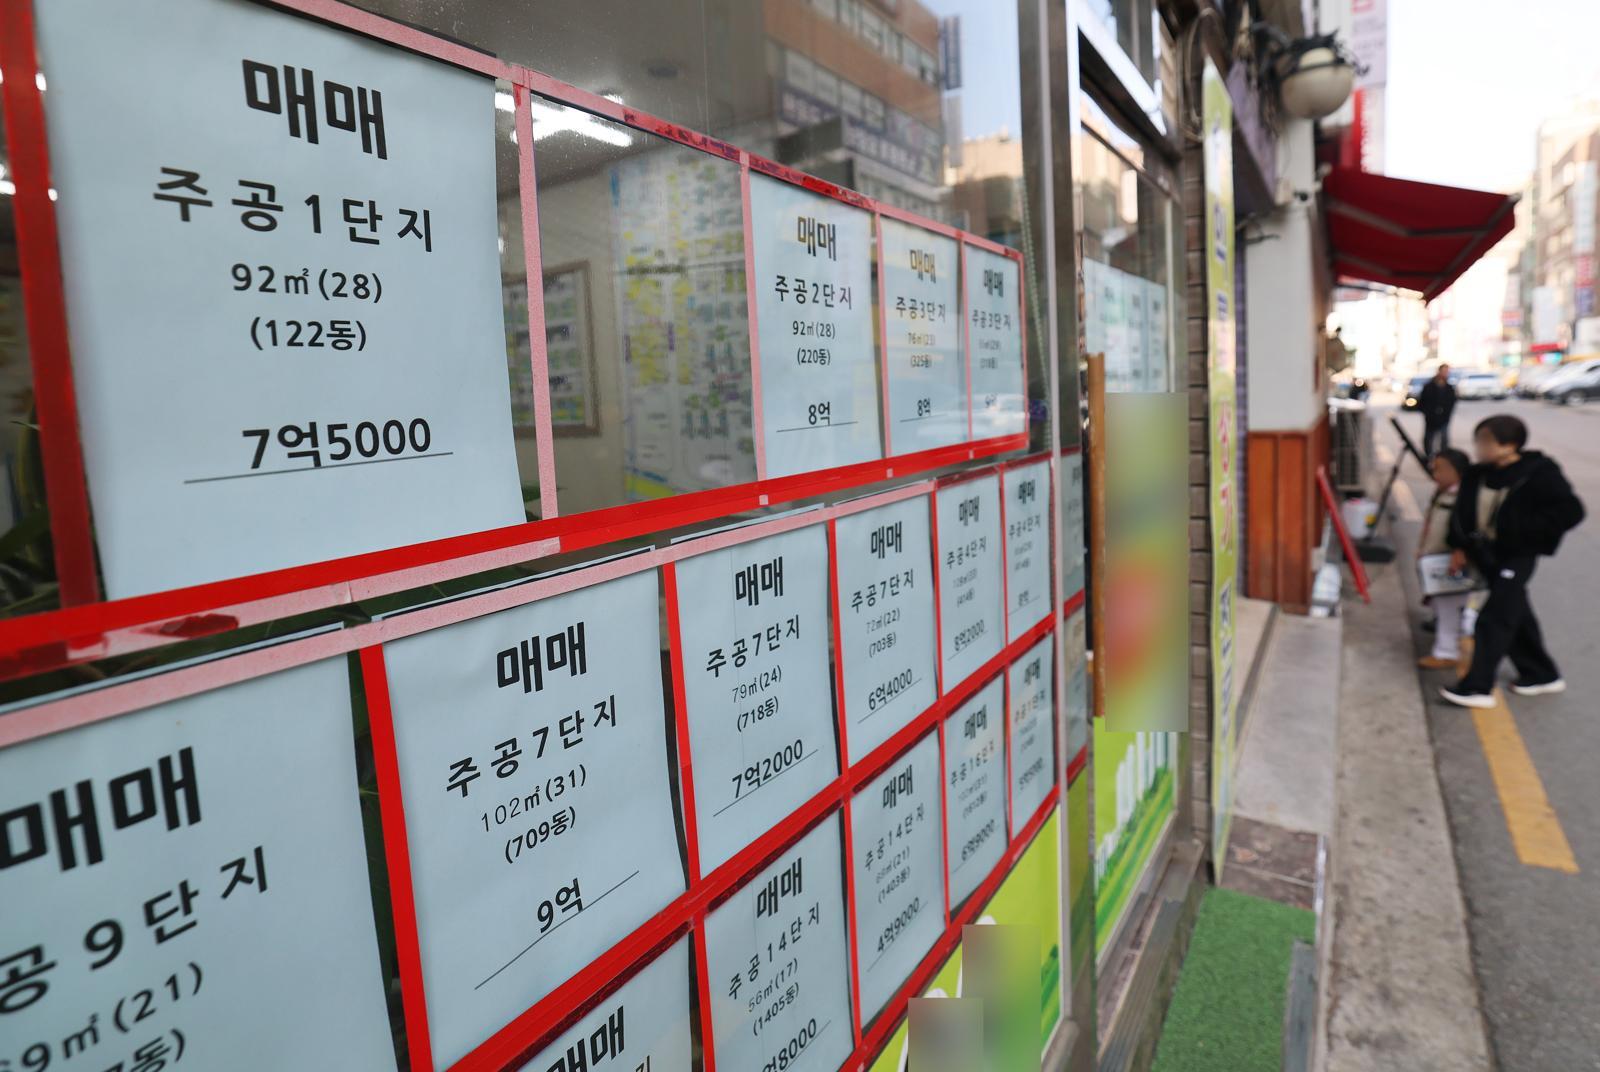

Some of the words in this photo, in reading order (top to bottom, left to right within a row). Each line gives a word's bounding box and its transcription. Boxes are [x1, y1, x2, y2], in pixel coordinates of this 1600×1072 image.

[243, 59, 388, 160] 매매
[153, 167, 432, 252] 주공1단지
[797, 217, 836, 261] 매매
[232, 263, 382, 303] 92㎡(28)
[910, 250, 936, 283] 매매
[984, 270, 1003, 297] 매매
[775, 275, 851, 310] 주공2단지
[896, 297, 945, 322] 주공3단지
[250, 317, 367, 351] (122동)
[797, 348, 830, 365] (220동)
[809, 401, 830, 425] 8억
[918, 399, 931, 416] 8억
[243, 418, 431, 469] 7억5000
[958, 496, 980, 526] 매매
[1018, 479, 1035, 504] 매매
[871, 521, 902, 559] 매매
[735, 556, 784, 606] 매매
[851, 568, 914, 614] 주공7단지
[497, 622, 587, 693] 매매
[707, 615, 800, 678] 주공7단지
[869, 631, 897, 658] (703동)
[868, 668, 913, 711] 6억4000
[737, 696, 779, 732] (718동)
[964, 704, 986, 740] 매매
[446, 695, 617, 797] 주공7단지
[732, 739, 803, 799] 7억2000
[0, 746, 201, 872] 매매
[883, 764, 913, 809] 매매
[505, 806, 576, 864] (709동)
[865, 803, 924, 871] 주공14단지
[537, 878, 583, 934] 9억
[757, 857, 802, 918] 매매
[0, 846, 267, 1014] 공9단지
[877, 897, 919, 952] 4억9000
[729, 902, 819, 1000] 주공14단지
[0, 961, 202, 1072] 9㎡(21)
[753, 982, 799, 1036] (1405동)
